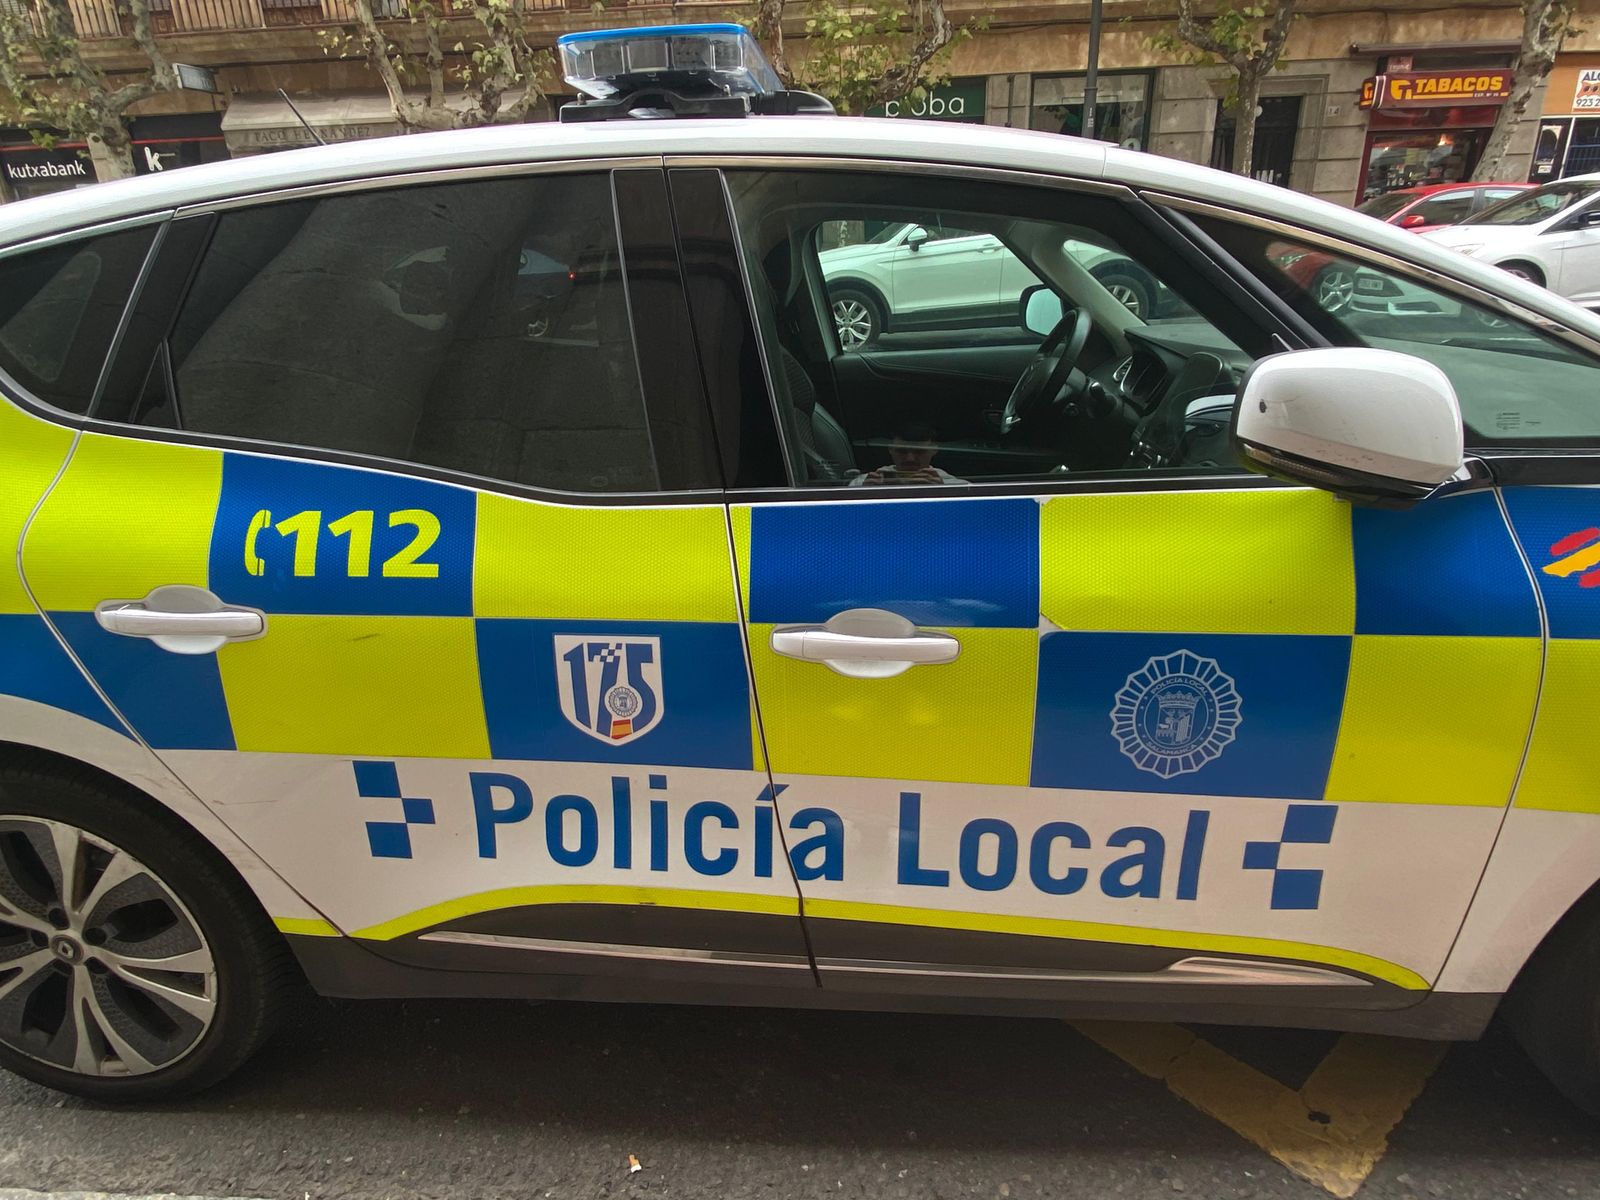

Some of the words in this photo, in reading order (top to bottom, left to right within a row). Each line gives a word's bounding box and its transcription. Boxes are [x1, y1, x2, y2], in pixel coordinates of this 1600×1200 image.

[1416, 77, 1504, 93] TABACOS
[885, 91, 964, 117] poba
[1576, 98, 1593, 107] 923
[294, 126, 370, 141] HENANDEZ
[7, 160, 86, 178] kutxabank
[275, 509, 441, 578] 112
[563, 642, 656, 738] 175
[469, 772, 844, 881] Policía
[897, 791, 1210, 901] Local
